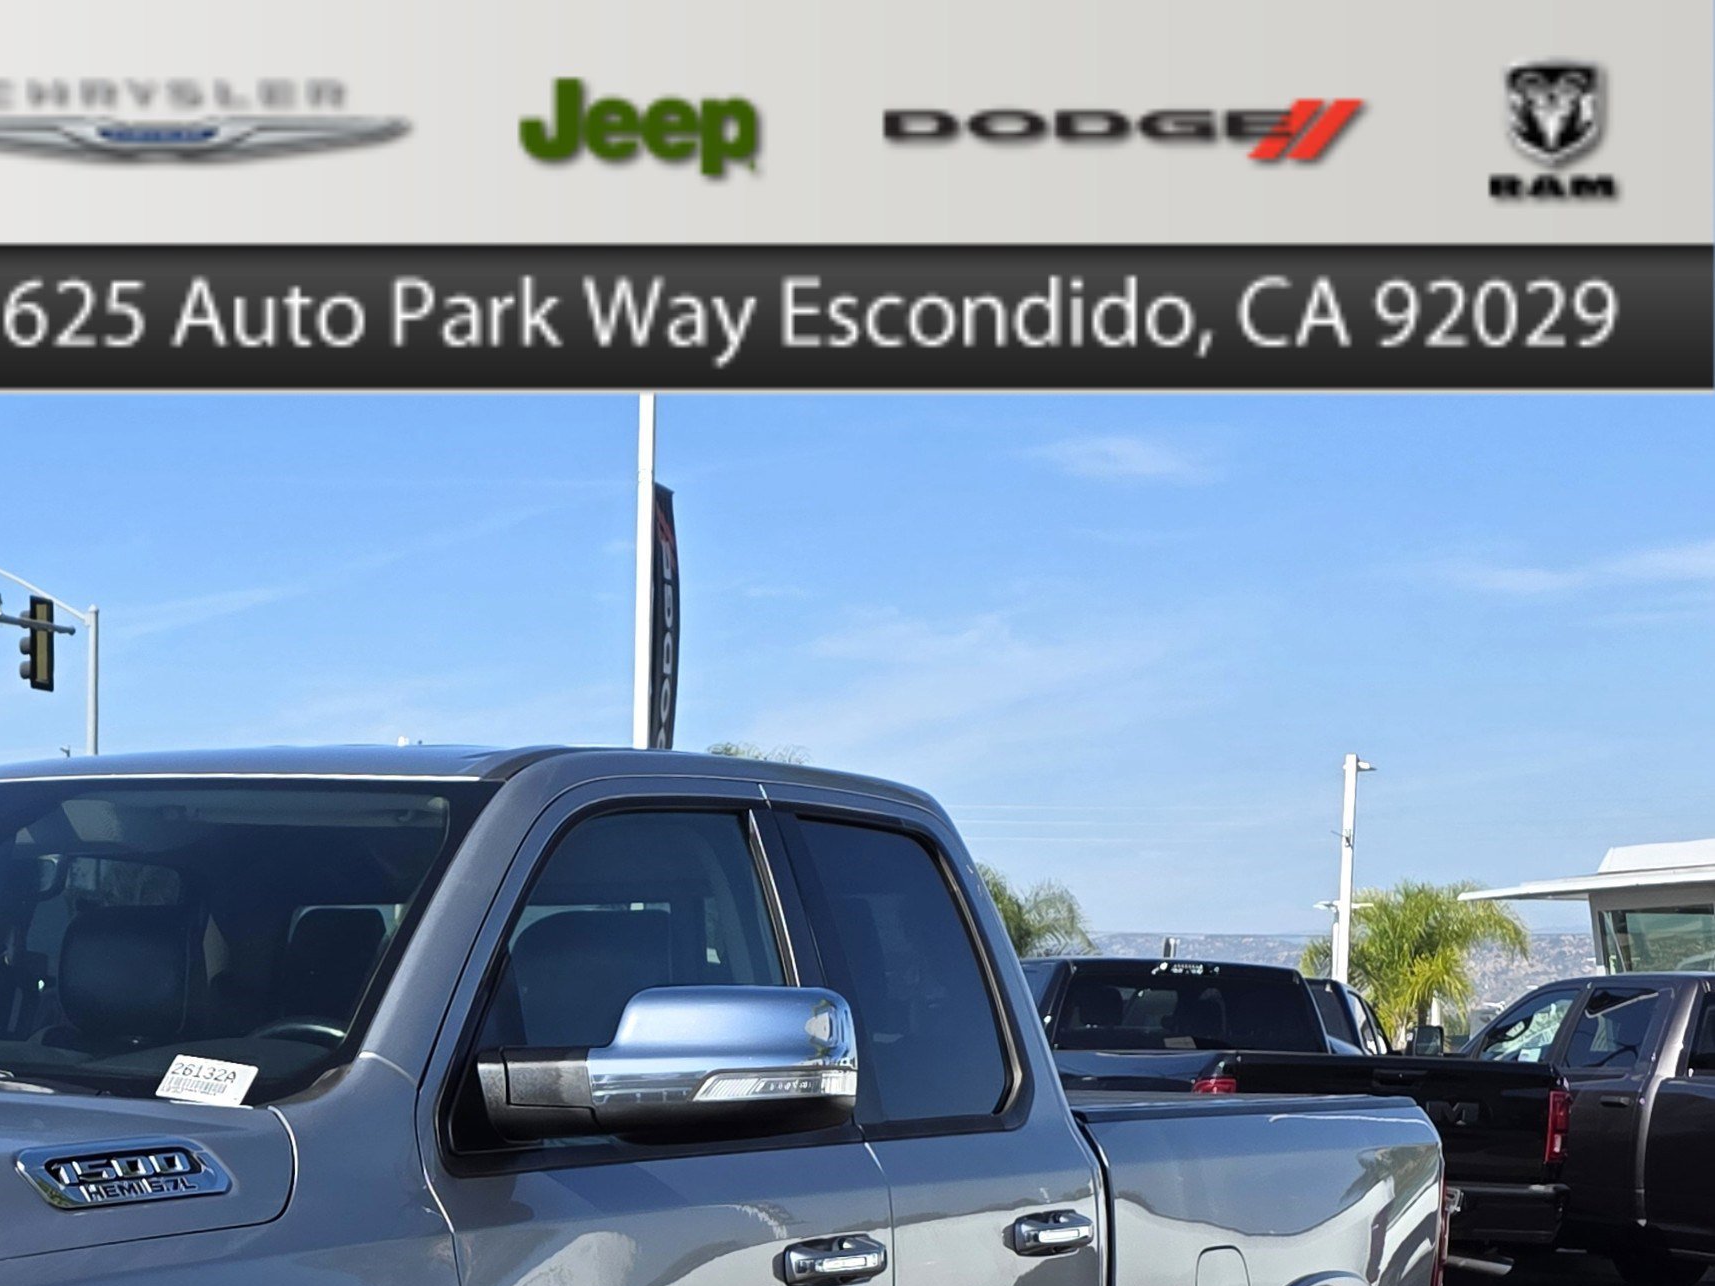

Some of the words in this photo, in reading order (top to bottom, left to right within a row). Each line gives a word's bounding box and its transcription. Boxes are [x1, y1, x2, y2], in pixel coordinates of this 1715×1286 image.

[170, 1062, 237, 1084] 26132A
[52, 1151, 191, 1186] 1500
[79, 1178, 146, 1203] HEMI
